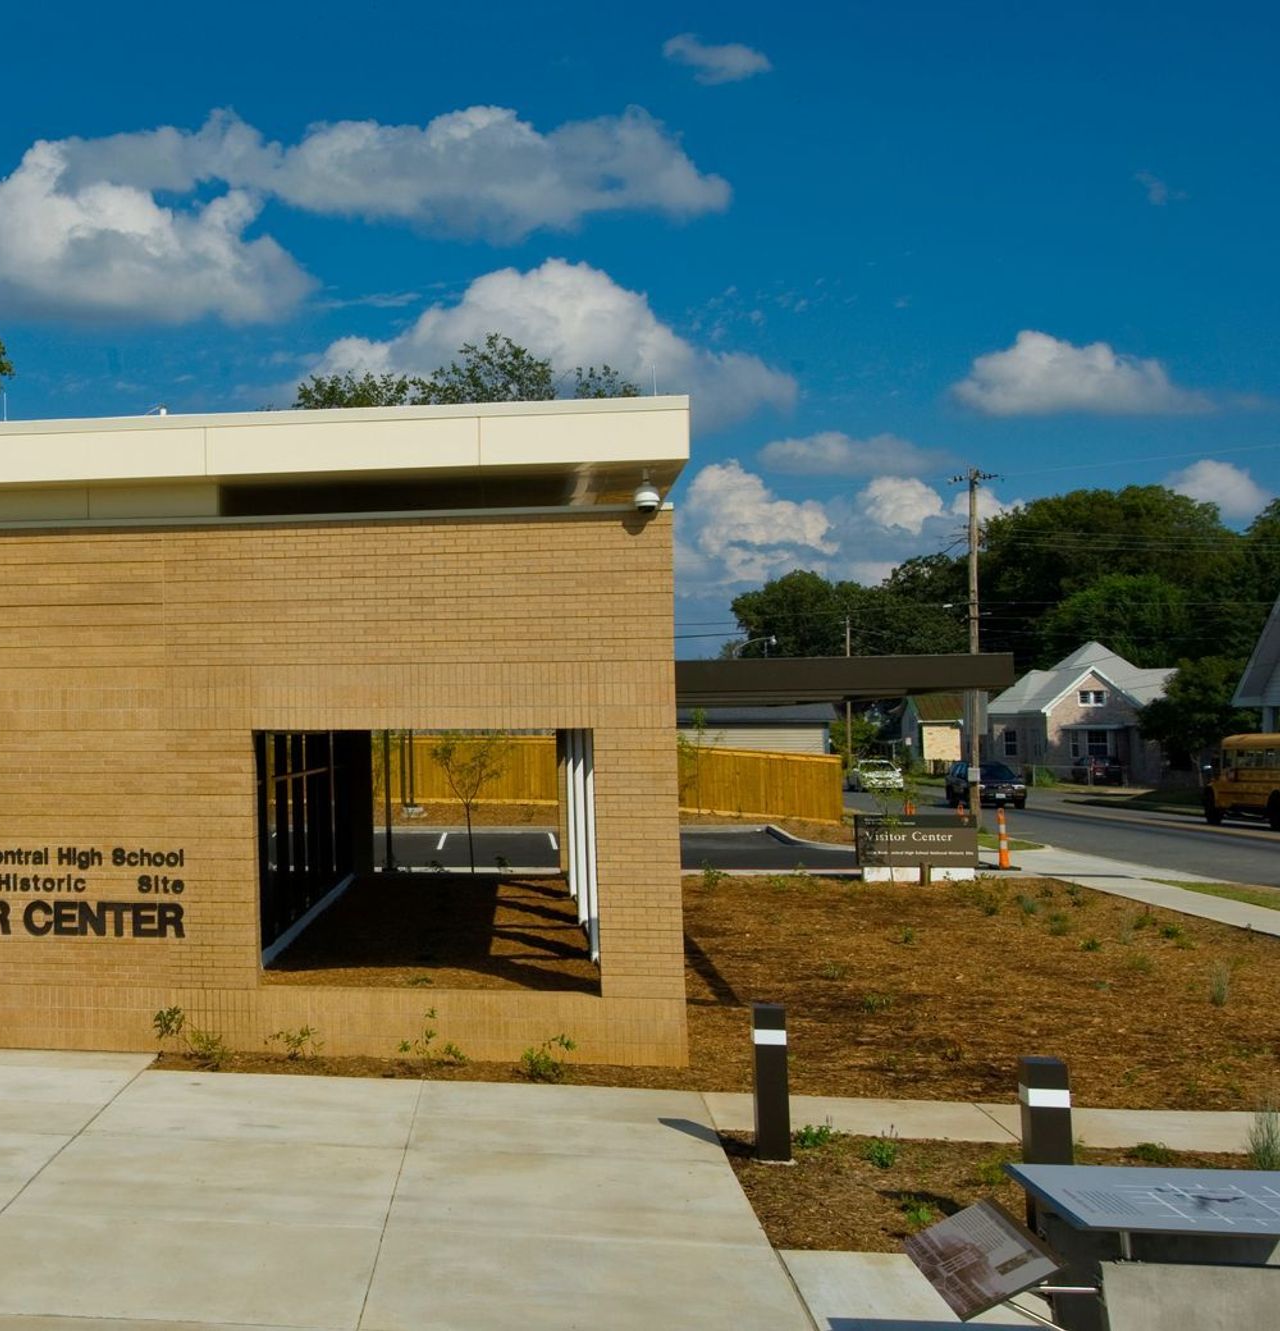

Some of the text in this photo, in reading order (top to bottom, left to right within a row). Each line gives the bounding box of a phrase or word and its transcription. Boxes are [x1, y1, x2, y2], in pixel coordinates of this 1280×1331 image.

[865, 831, 953, 841] Visitor Center
[57, 847, 103, 870] High
[112, 848, 185, 867] School
[137, 875, 185, 894] Site
[23, 900, 185, 938] CENTER
